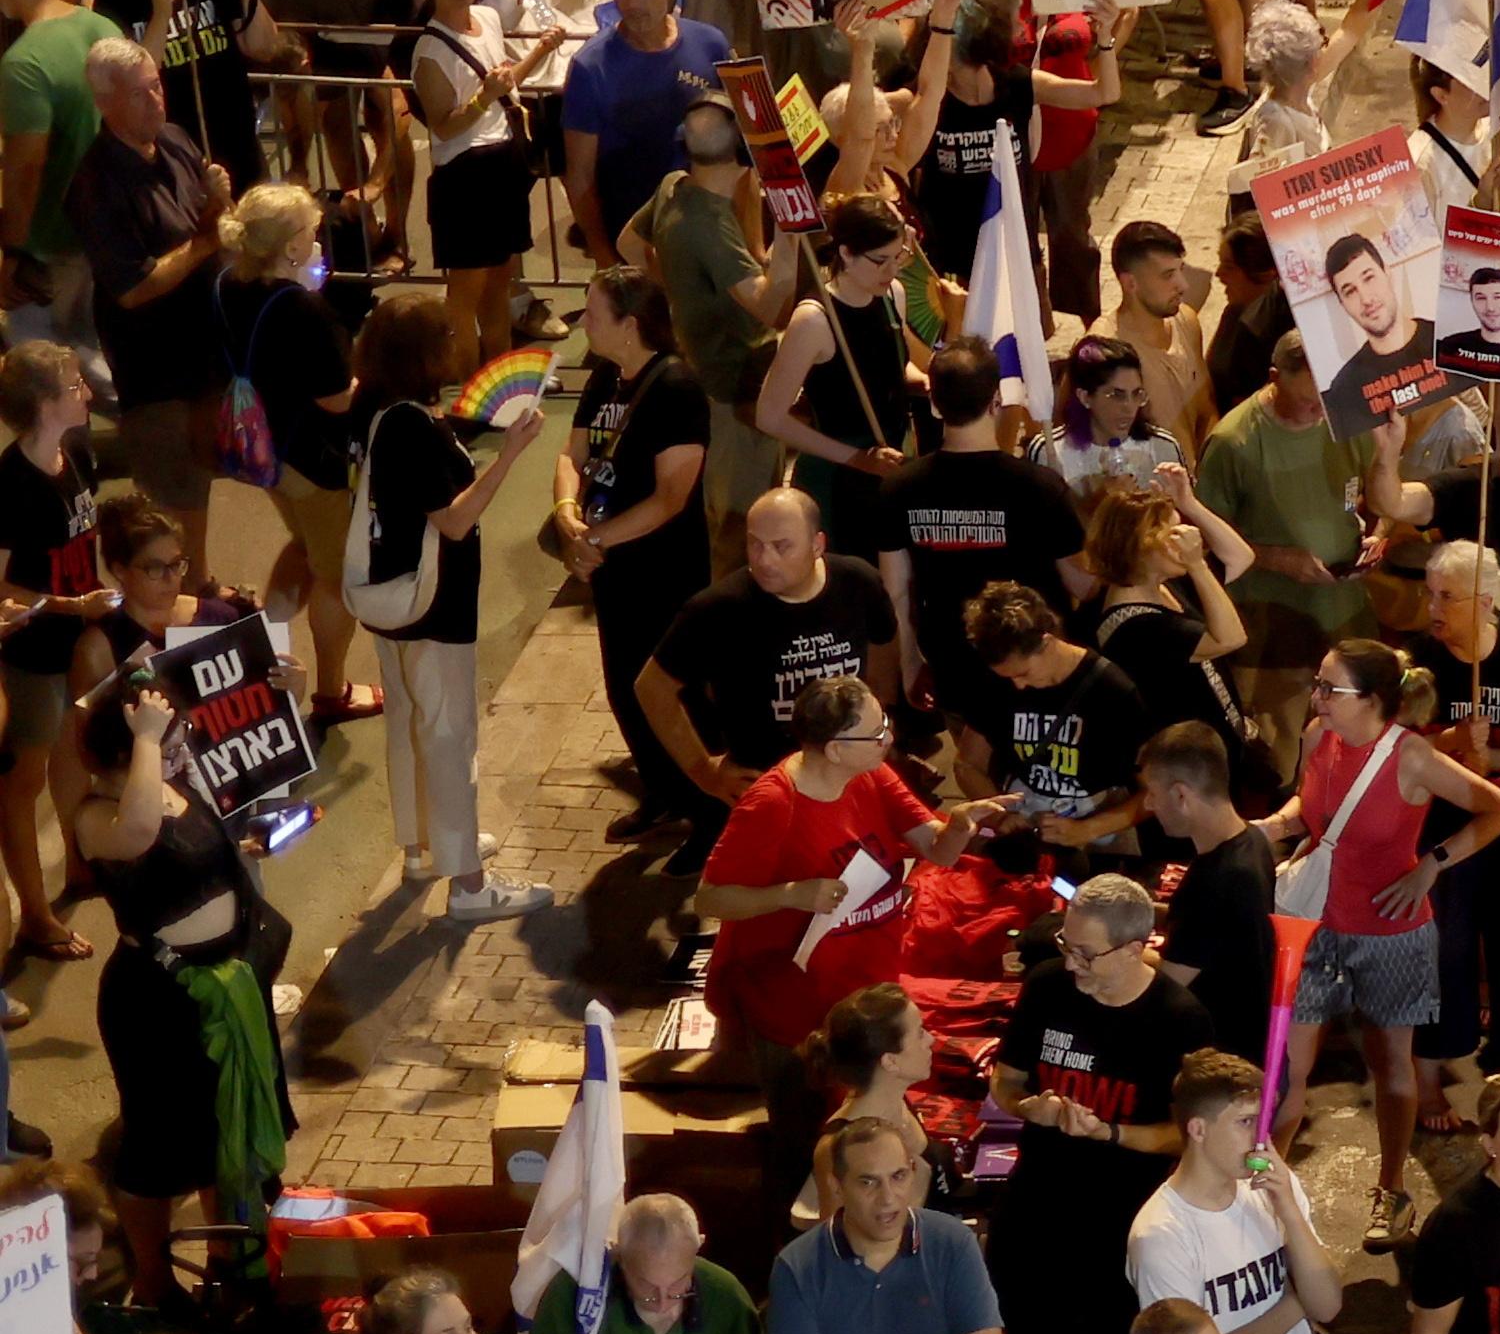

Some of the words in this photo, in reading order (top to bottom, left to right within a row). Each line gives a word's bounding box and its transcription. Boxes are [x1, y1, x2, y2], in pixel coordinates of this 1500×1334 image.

[1270, 202, 1296, 220] was
[1296, 180, 1349, 211] murdered
[1363, 157, 1411, 188] captivity
[1282, 166, 1315, 201] ITAY
[1318, 144, 1386, 187] SVIRSKY
[1309, 201, 1335, 219] after
[1338, 194, 1355, 211] 99
[1357, 185, 1383, 205] days
[191, 648, 245, 698] עם
[190, 683, 276, 741] חטוף
[199, 717, 297, 789] בארצו
